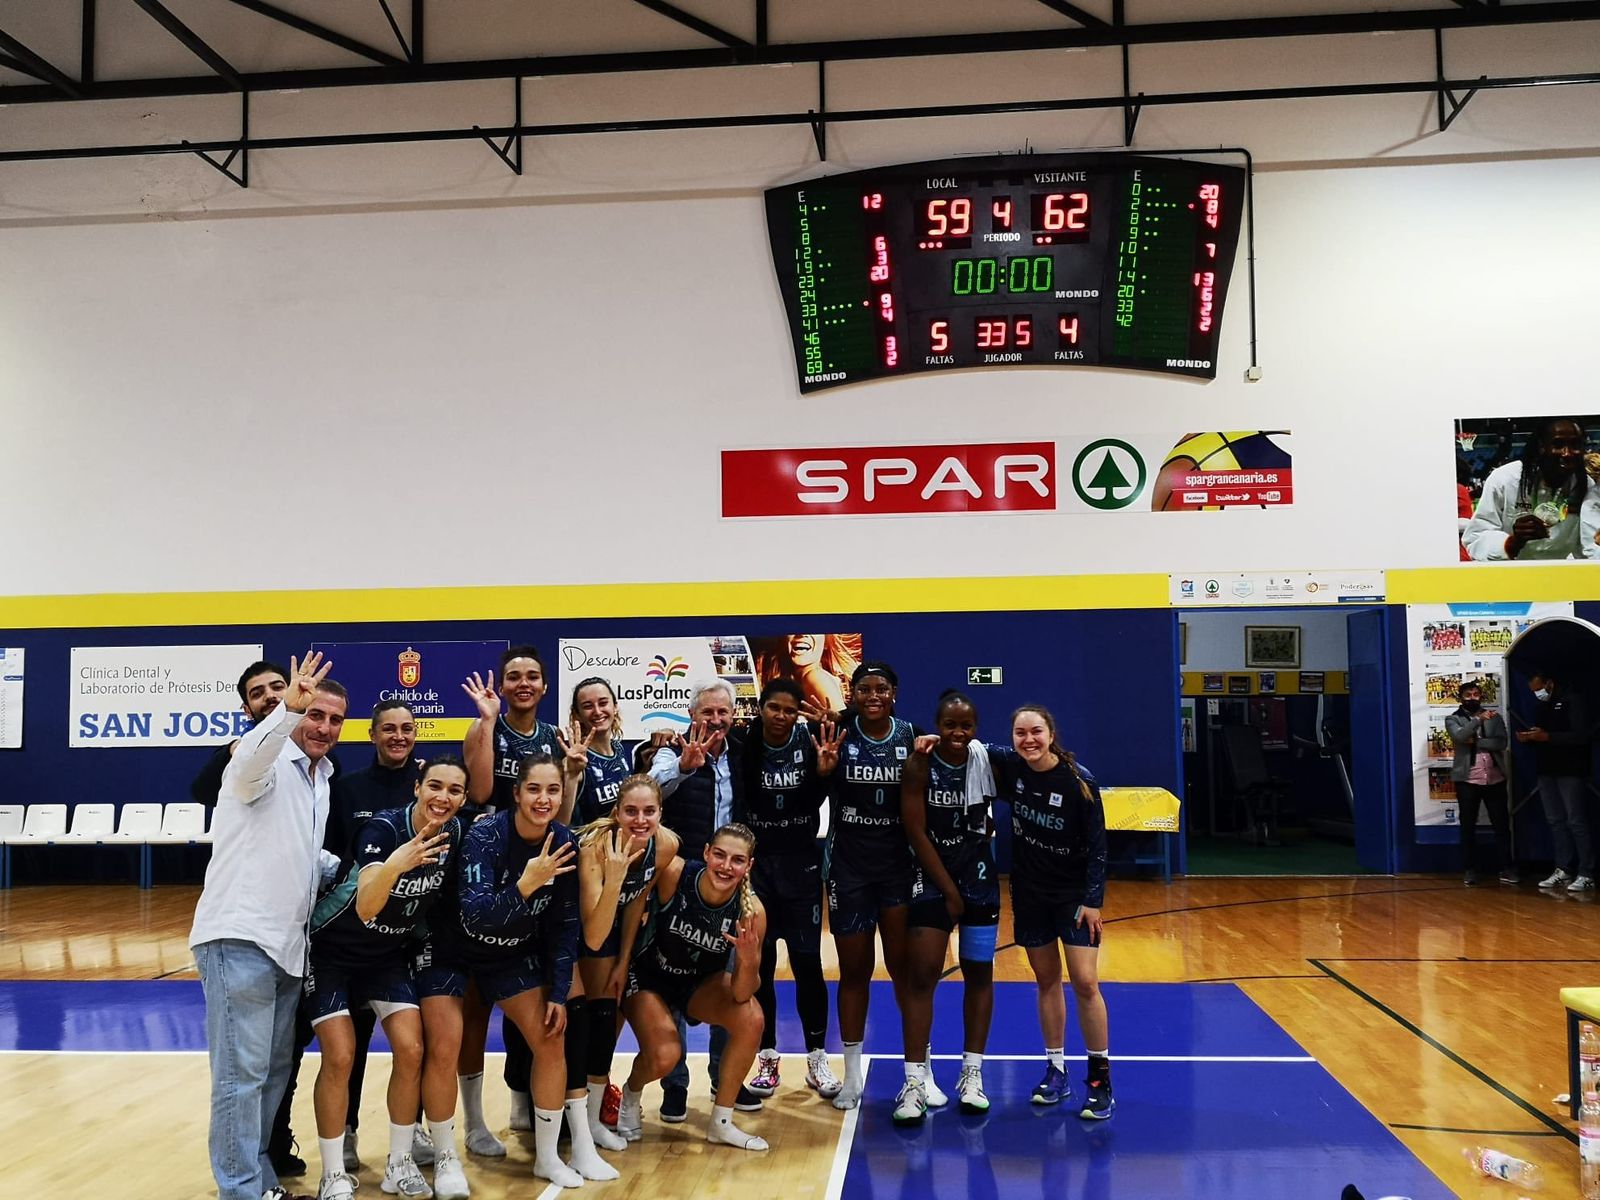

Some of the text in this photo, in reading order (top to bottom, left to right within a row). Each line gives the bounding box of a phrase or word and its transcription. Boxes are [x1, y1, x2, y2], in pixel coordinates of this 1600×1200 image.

[926, 178, 958, 189] LOCAL
[1034, 171, 1087, 183] VISITANTE
[1134, 169, 1141, 182] E
[798, 191, 805, 202] E
[863, 193, 882, 209] 12
[927, 198, 971, 236] 59
[993, 201, 1011, 227] 4
[1044, 193, 1088, 230] 62
[984, 232, 1021, 242] PERIODO
[953, 257, 1052, 294] 00:00
[1055, 289, 1099, 299] MONDO
[931, 322, 948, 351] 5
[977, 321, 1030, 347] 33 5
[1059, 318, 1078, 344] 4
[925, 355, 955, 365] FALTAS
[984, 353, 1023, 363] JUGADOR
[1054, 351, 1084, 360] FALTAS
[1166, 358, 1211, 369] MONDO
[804, 372, 847, 384] MONDO
[796, 454, 1050, 504] SPAR
[1185, 471, 1278, 487] spargrancanaria.es
[562, 645, 641, 671] Descubre
[80, 666, 172, 680] Clínica Dental y
[80, 682, 146, 695] Laboratorio
[150, 682, 164, 693] de
[168, 681, 211, 693] Prótesis
[379, 688, 439, 701] Cabildo de
[79, 712, 152, 738] SAN
[845, 764, 902, 781] LEGANÉ
[775, 794, 784, 810] 8
[875, 788, 884, 805] 0
[952, 811, 961, 828] 2
[1014, 800, 1065, 831] EGANÉS
[464, 863, 481, 883] 11
[977, 861, 987, 880] 2
[812, 904, 820, 924] 8
